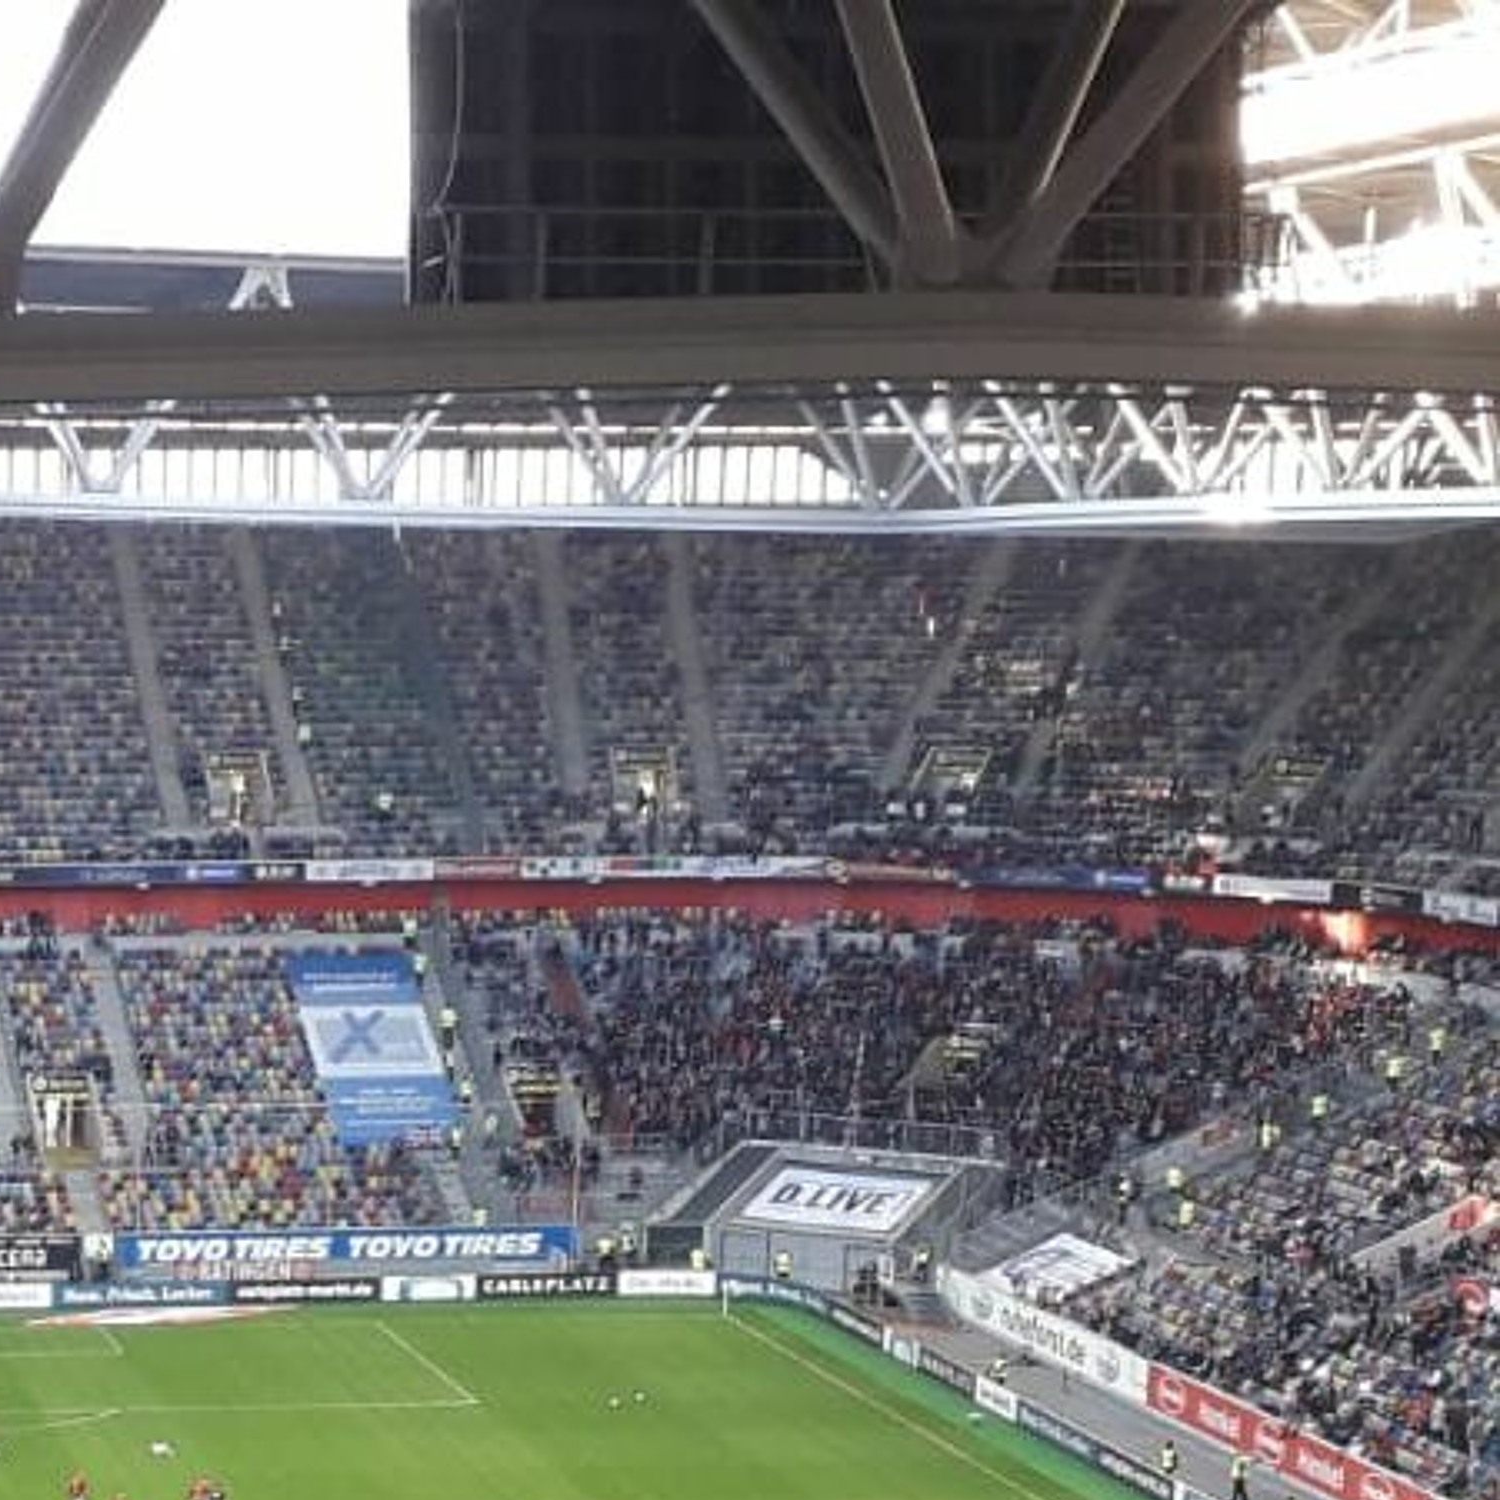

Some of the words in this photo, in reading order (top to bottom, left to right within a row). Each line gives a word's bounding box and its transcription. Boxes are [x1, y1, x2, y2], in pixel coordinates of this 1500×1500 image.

[136, 1238, 235, 1261] TOYO
[235, 1236, 332, 1259] TIRES
[350, 1235, 439, 1258] TOYO
[443, 1232, 542, 1257] TIRES
